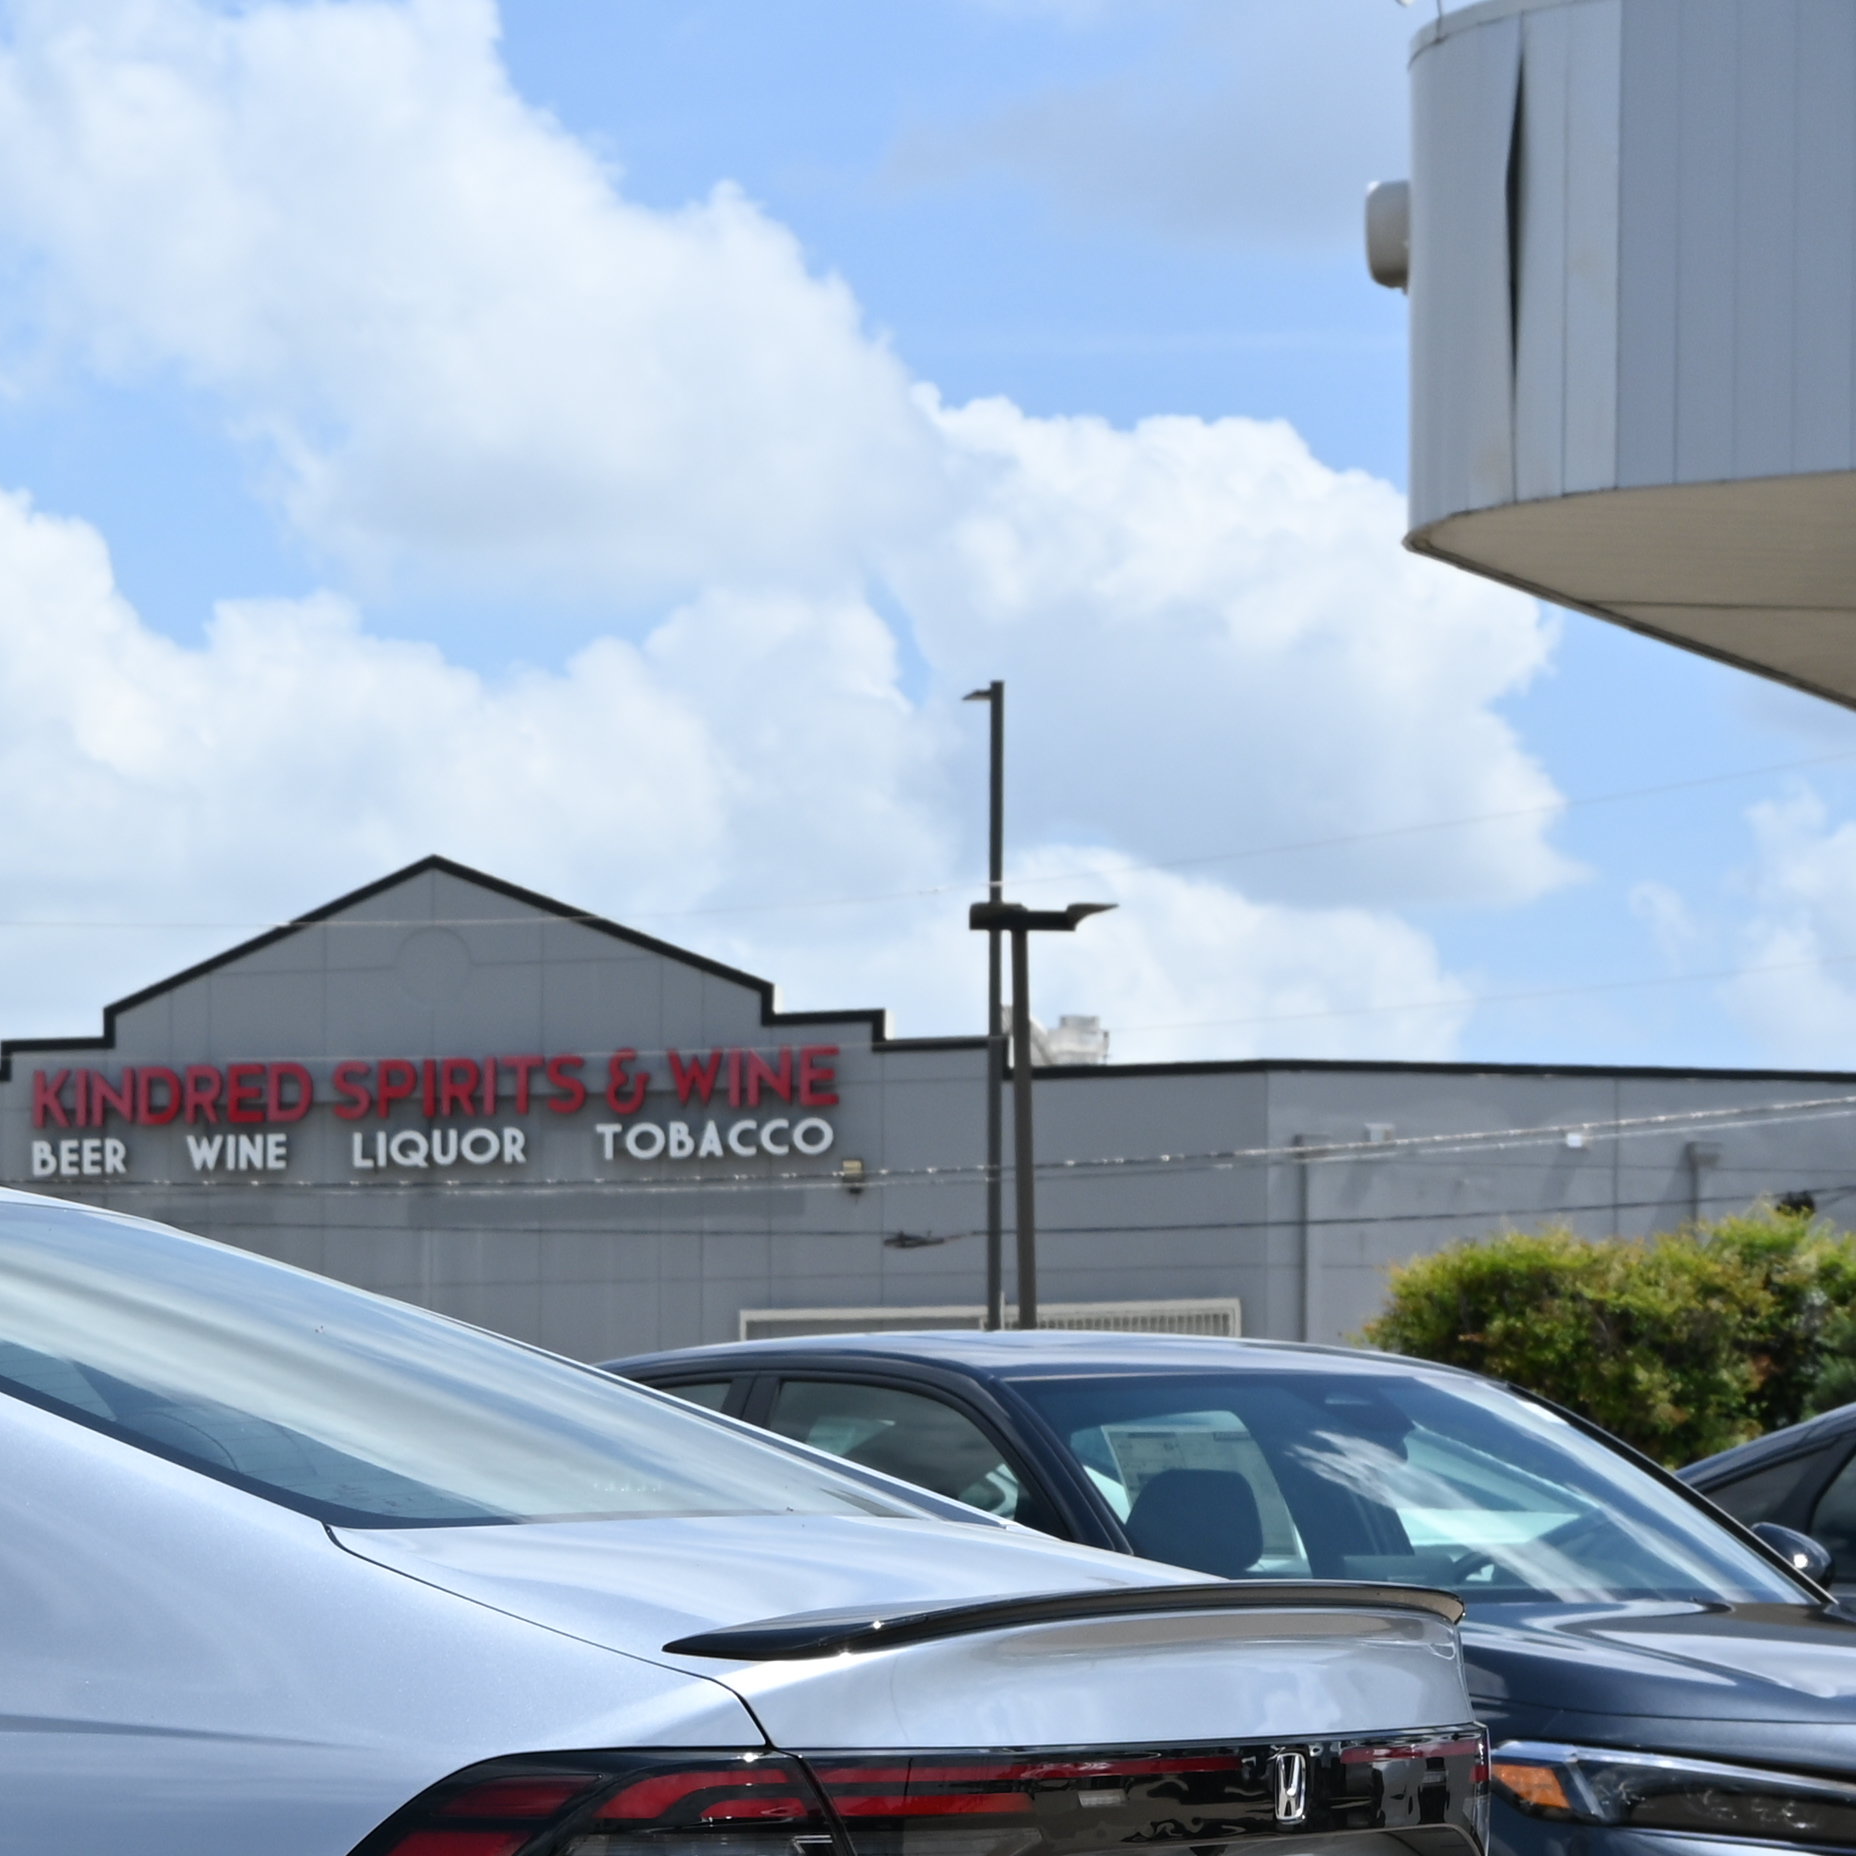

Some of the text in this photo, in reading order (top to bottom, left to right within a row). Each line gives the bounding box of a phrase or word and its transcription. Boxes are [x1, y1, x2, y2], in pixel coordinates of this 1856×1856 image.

[32, 1044, 841, 1129] KINDRED SPIRITS & WINE
[32, 1117, 835, 1177] BEER WINE LIQUOR TOBACCO
